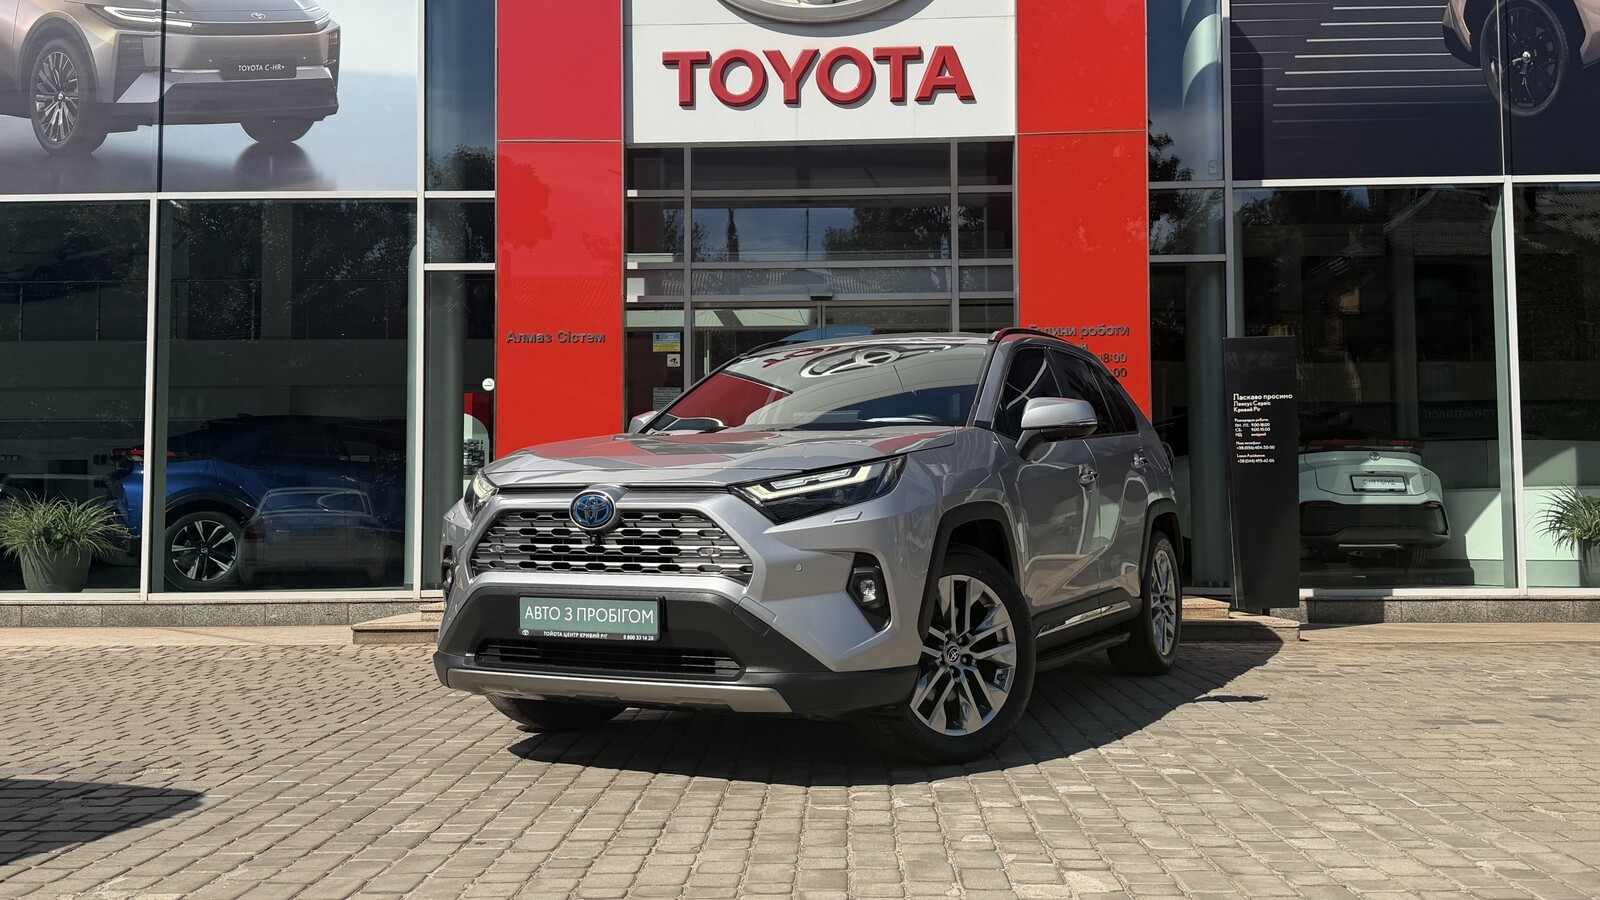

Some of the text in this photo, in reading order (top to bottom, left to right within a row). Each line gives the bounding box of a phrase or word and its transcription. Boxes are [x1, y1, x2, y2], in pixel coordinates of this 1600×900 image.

[662, 45, 976, 107] TOYOTA
[506, 331, 606, 343] Алмаз Сістем
[1080, 324, 1130, 339] роботи
[1233, 393, 1262, 401] Ласкаво
[524, 605, 654, 624] АВТО З ПРОБІГОМ
